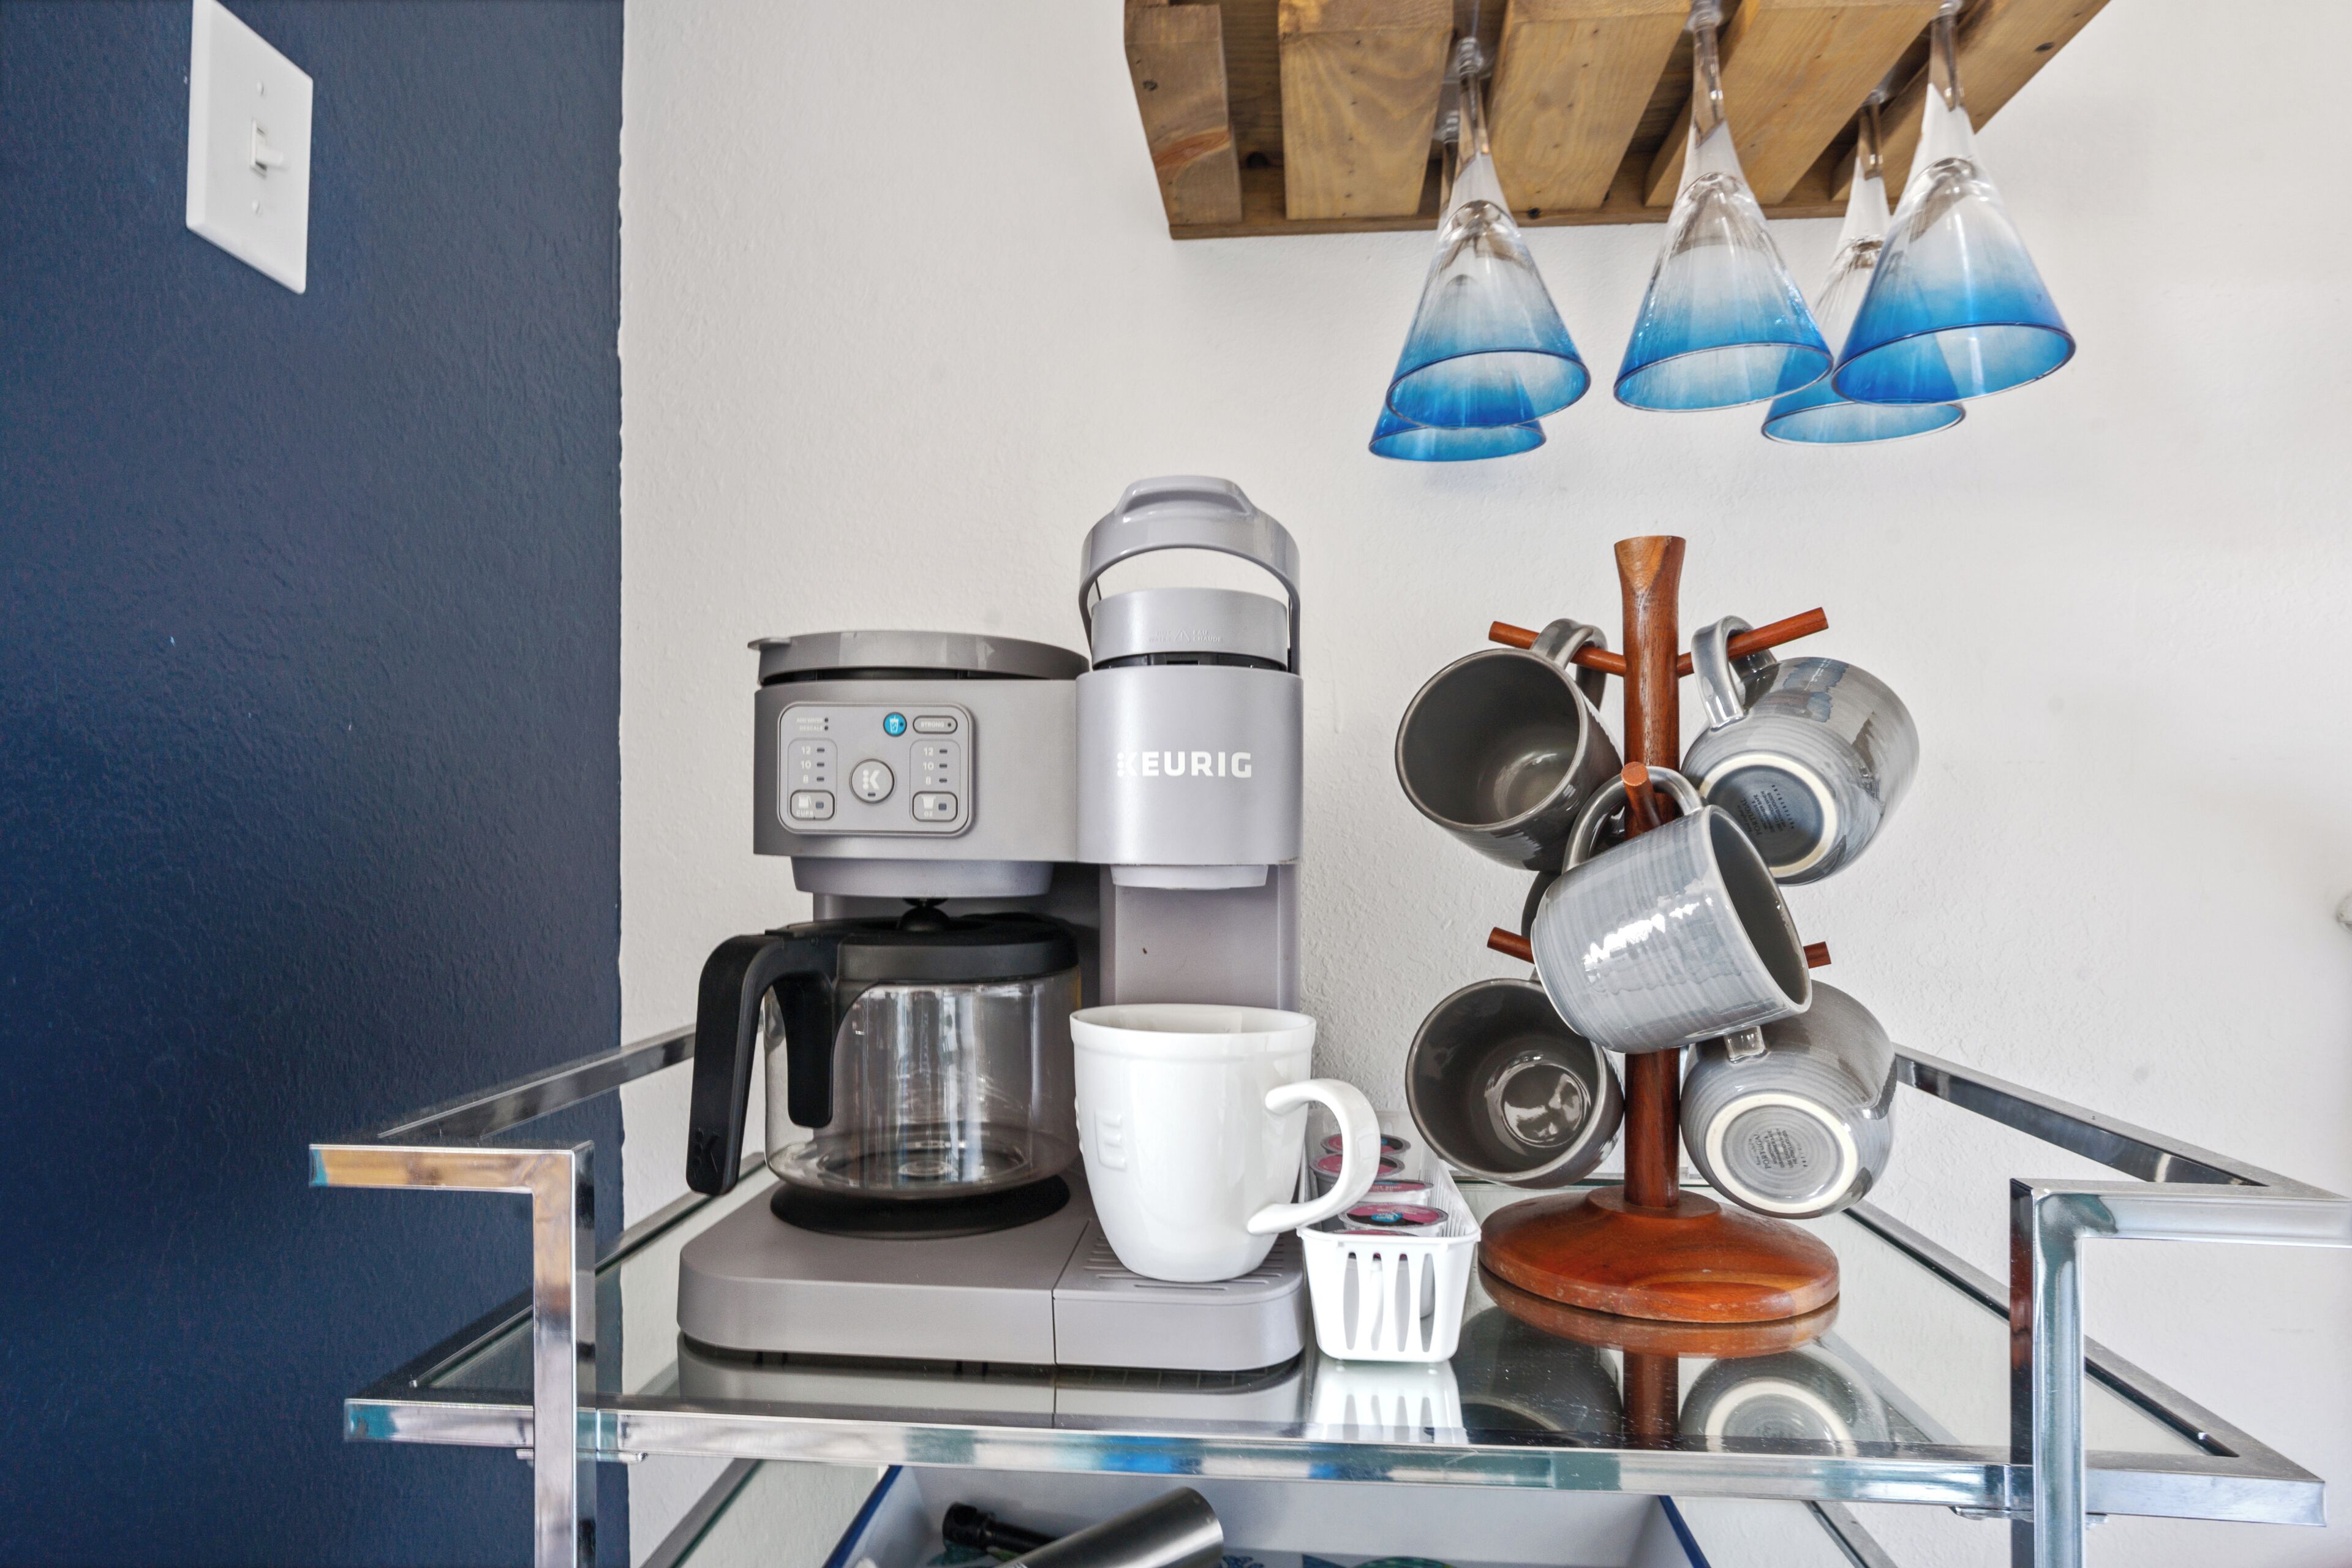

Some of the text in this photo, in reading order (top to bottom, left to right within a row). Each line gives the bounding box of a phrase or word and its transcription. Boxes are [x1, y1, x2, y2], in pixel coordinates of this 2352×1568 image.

[801, 746, 811, 755] 12
[923, 747, 933, 756] 12
[801, 760, 812, 769] 10
[922, 761, 934, 771] 10
[1117, 750, 1252, 778] KEURIG
[803, 774, 809, 783] 8
[1760, 791, 1770, 804] WHEN
[1741, 798, 1762, 835] PORTUGAL
[1754, 1133, 1771, 1169] PORTUGAL
